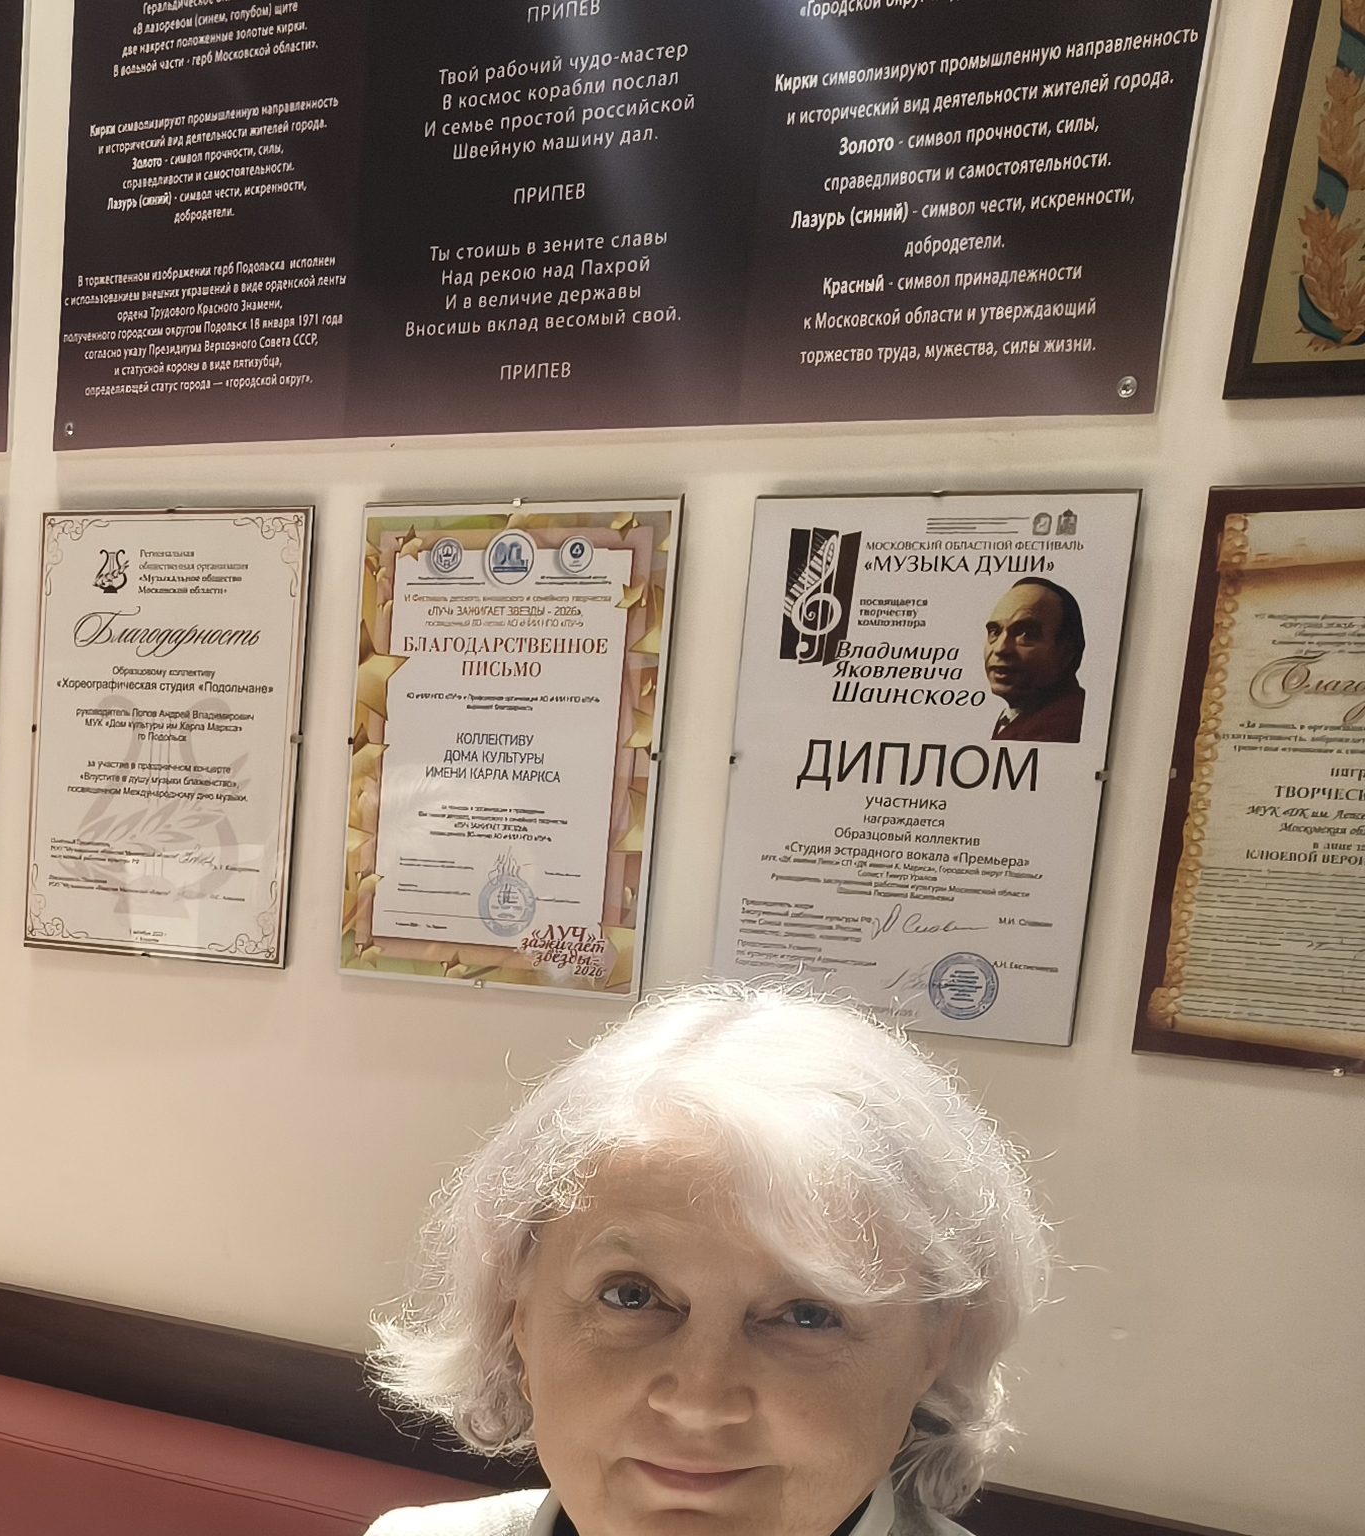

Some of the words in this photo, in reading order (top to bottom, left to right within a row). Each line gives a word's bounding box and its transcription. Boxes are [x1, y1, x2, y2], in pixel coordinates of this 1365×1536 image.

[527, 0, 601, 23] ПРИПЕВ
[513, 182, 585, 205] ПРИПЕВ
[429, 245, 450, 262] Ты
[456, 243, 521, 261] стоишь
[526, 241, 537, 256] в
[542, 236, 605, 254] зените
[611, 231, 667, 249] славы
[441, 269, 474, 287] Над
[479, 267, 536, 287] рекою
[542, 264, 574, 280] над
[580, 255, 650, 278] Пахрой
[823, 273, 885, 299] Красный
[897, 274, 951, 291] символ
[954, 265, 1083, 291] принадлежности
[445, 293, 457, 310] И
[463, 296, 472, 309] в
[478, 291, 553, 308] величие
[557, 285, 641, 306] державы
[116, 309, 148, 323] ордена
[149, 305, 196, 321] Трудового
[196, 302, 240, 318] Красного
[240, 299, 283, 312] Знамени,
[405, 320, 481, 338] Вносишь
[487, 316, 539, 333] вклад
[545, 308, 626, 330] весомый
[632, 305, 681, 324] свой.
[803, 316, 812, 330] к
[814, 307, 901, 330] Московской
[904, 305, 963, 325] области
[966, 307, 977, 322] и
[978, 297, 1096, 325] утверждающий
[799, 347, 874, 367] торжество
[877, 345, 921, 364] труда,
[924, 341, 998, 362] мужества,
[1002, 340, 1040, 355] силы
[1043, 338, 1096, 353] жизни.
[500, 361, 571, 381] ПРИПЕВ
[864, 554, 970, 573] «МУЗЫКА
[974, 555, 1055, 577] ДУШИ»
[427, 605, 454, 617] «ЛУЧ»
[456, 605, 506, 617] ЗАЖИГАЕТ
[506, 605, 546, 618] ЗВЕЗДЫ
[553, 605, 584, 618] 2026»,
[859, 598, 929, 608] посвящается
[859, 608, 918, 619] творчеству
[73, 605, 262, 657] Благодарность
[857, 618, 927, 630] композитора
[403, 636, 609, 656] БЛАГОДАРСТВЕННОЕ
[837, 640, 960, 665] Владимира
[461, 660, 542, 678] ПИСЬМО
[832, 660, 963, 681] Яковлевича
[56, 677, 158, 693] «Хореографическая
[159, 682, 195, 695] студия
[198, 680, 274, 694] «Подольчане»
[832, 680, 986, 707] Шаинского
[455, 732, 535, 747] КОЛЛЕКТИВУ
[443, 749, 479, 765] ДОМА
[482, 750, 545, 765] КУЛЬТУРЫ
[795, 738, 1039, 792] ДИПЛОМ
[425, 765, 467, 780] ИМЕНИ
[469, 766, 509, 781] КАРЛА
[511, 769, 561, 784] МАРКСА
[864, 795, 947, 811] участника
[863, 813, 945, 828] награждается
[834, 826, 912, 847] Образцовый
[914, 834, 981, 847] коллектив
[784, 840, 832, 857] «Студия
[833, 845, 904, 860] эстрадного
[906, 850, 950, 863] вокала
[952, 851, 1030, 870] «Премьера»
[531, 924, 596, 942] «ЛУЧ»
[574, 965, 606, 977] 2026
